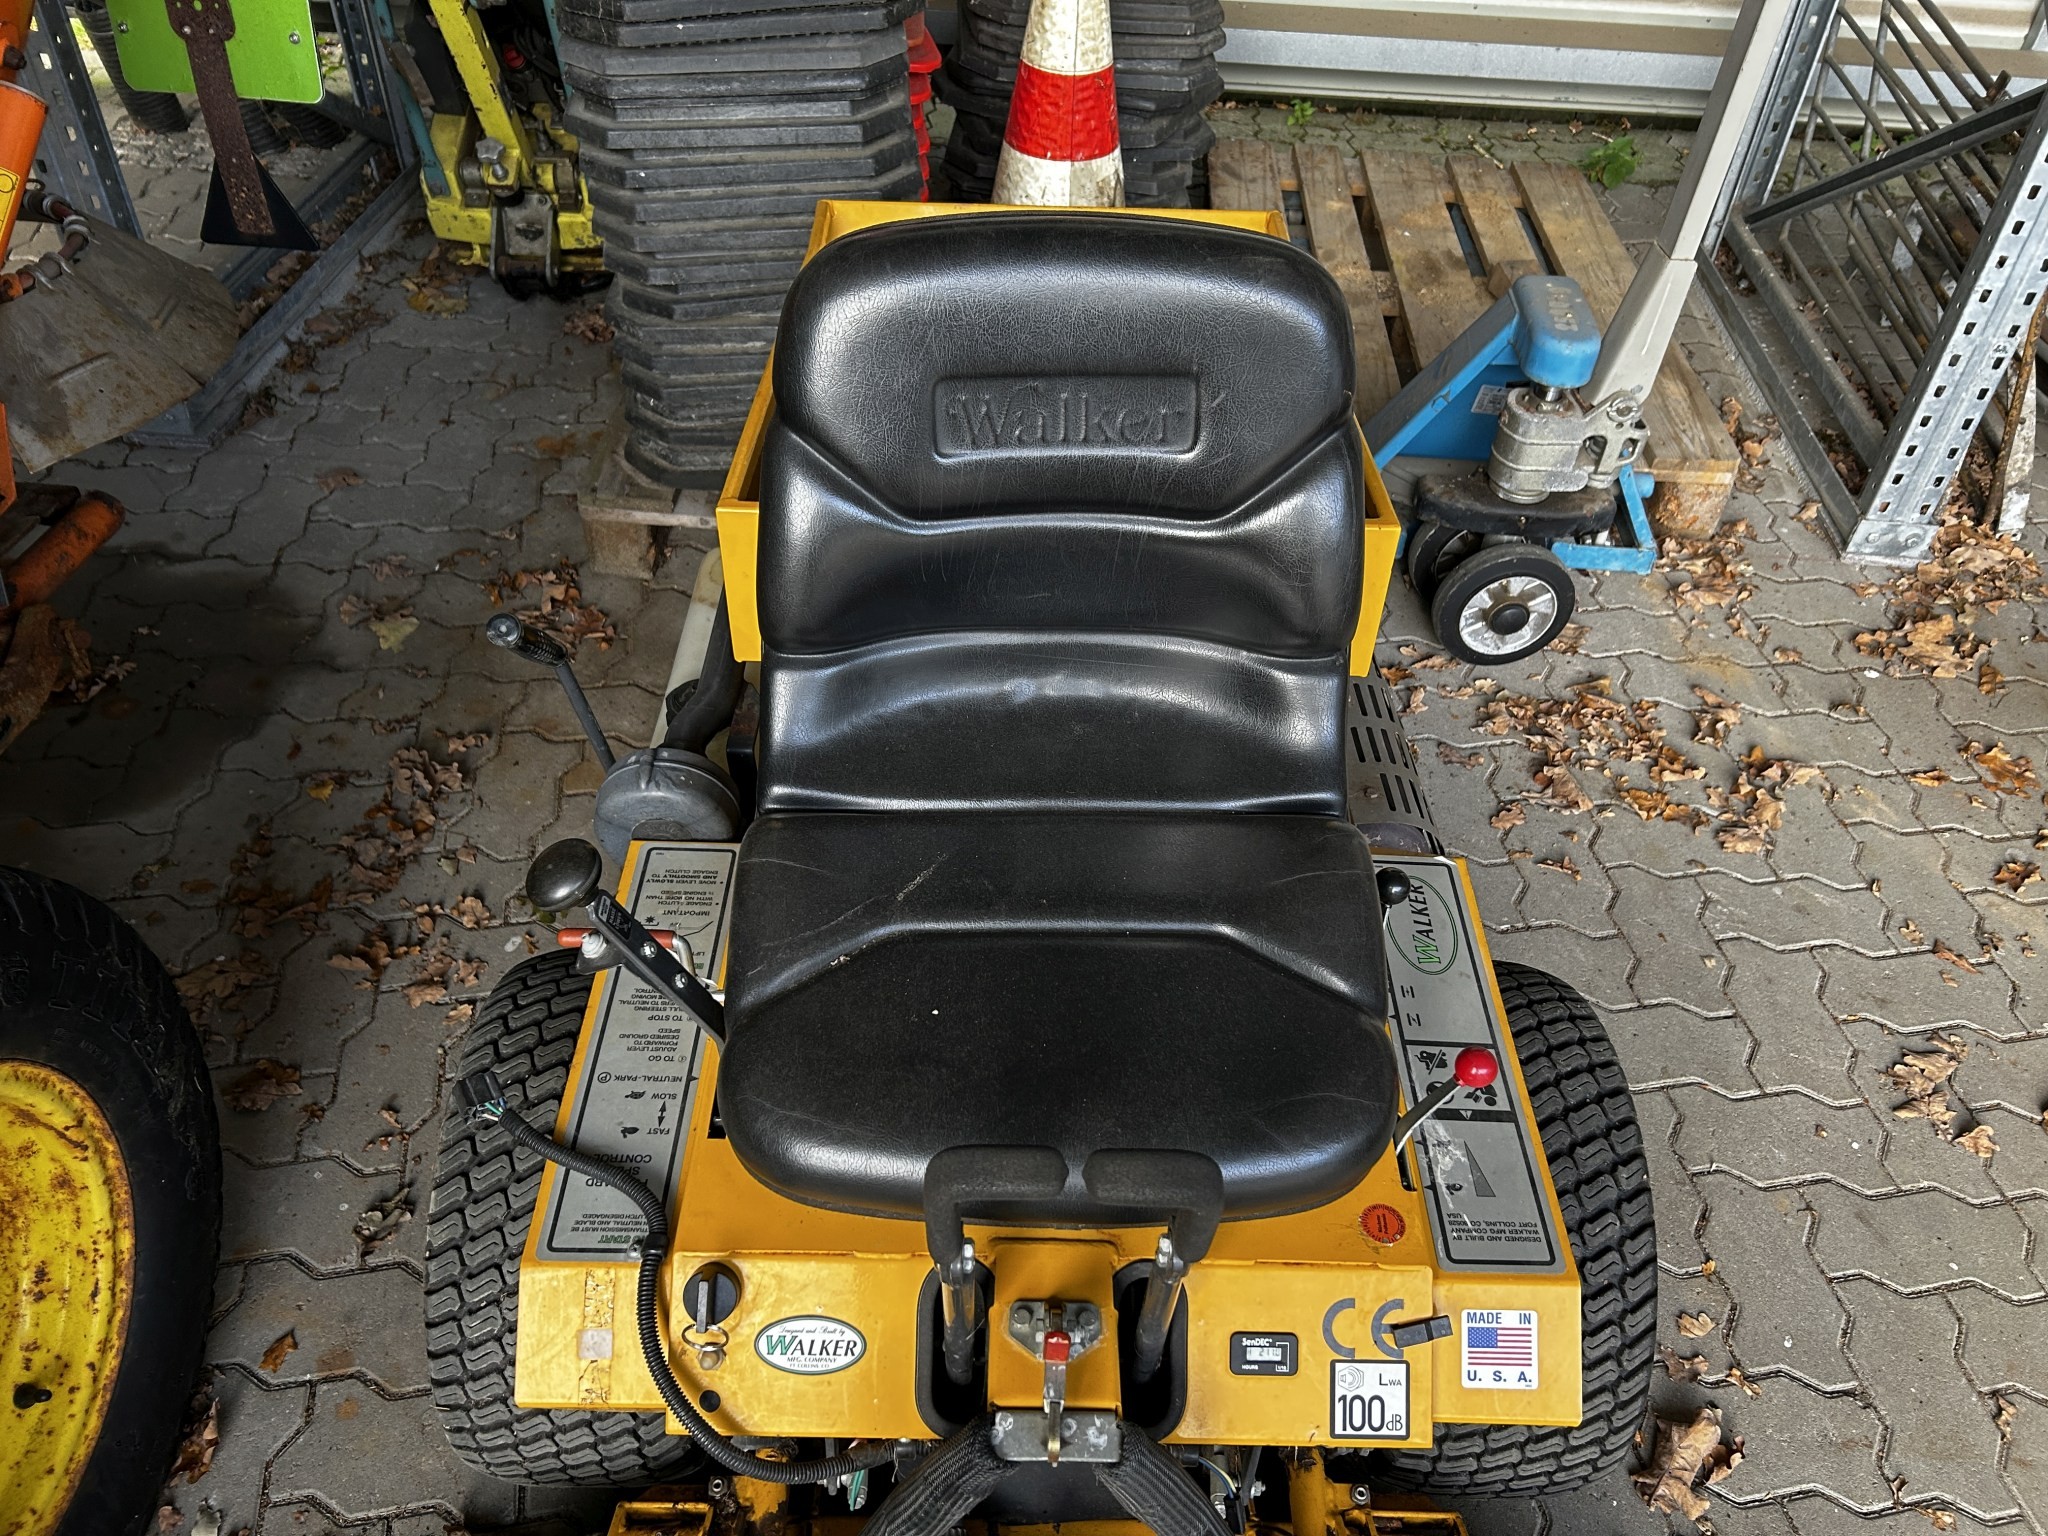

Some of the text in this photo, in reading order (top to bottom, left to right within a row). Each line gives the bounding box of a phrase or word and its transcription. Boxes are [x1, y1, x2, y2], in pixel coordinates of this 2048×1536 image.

[949, 392, 1184, 444] Walker
[1408, 884, 1441, 964] WALKER
[613, 1075, 683, 1083] NEUTRAL-PARK
[647, 1127, 670, 1135] FAST
[1466, 1312, 1532, 1325] MADE IN
[1322, 1297, 1404, 1359] CE
[765, 1334, 857, 1357] WALKER
[1242, 1337, 1270, 1347] SenDEC
